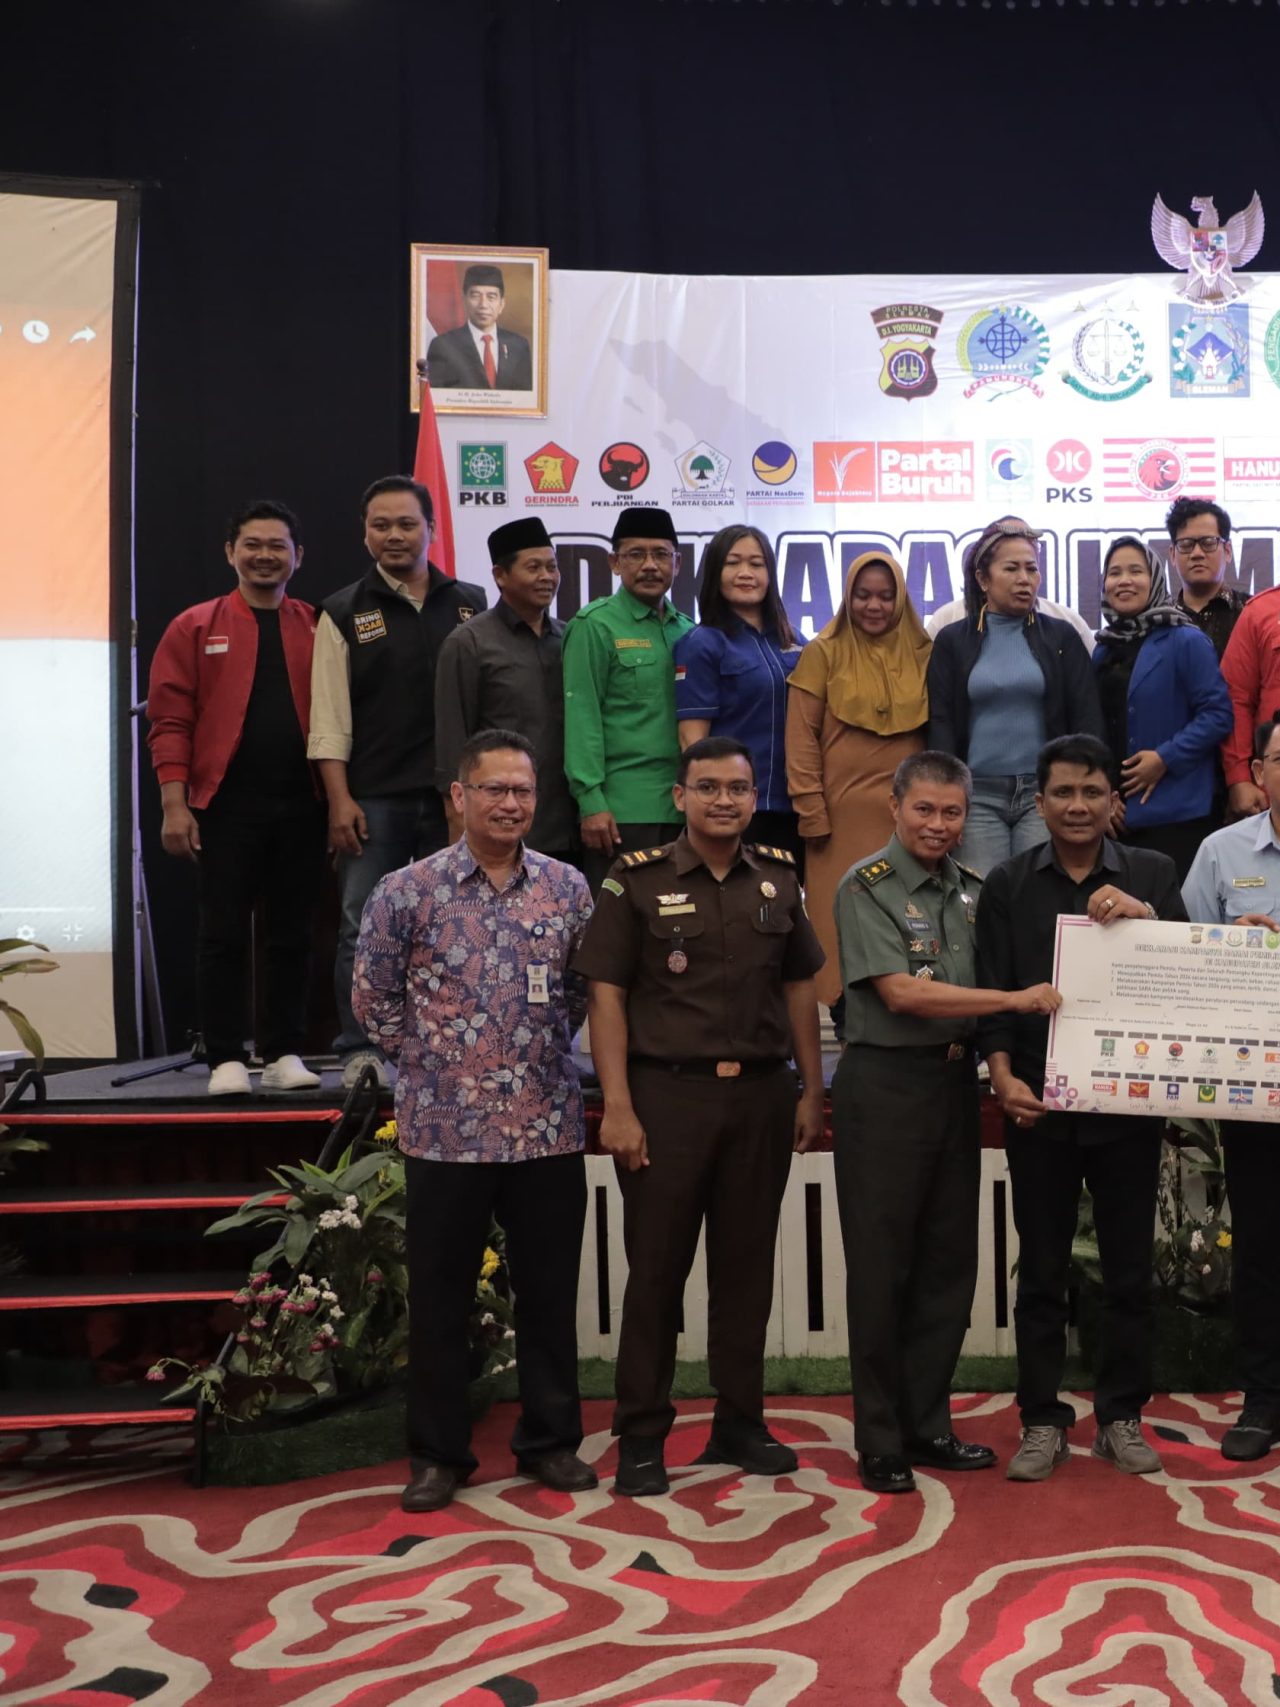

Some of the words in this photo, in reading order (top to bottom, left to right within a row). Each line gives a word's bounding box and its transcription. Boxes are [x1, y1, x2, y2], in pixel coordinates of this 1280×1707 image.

[892, 324, 932, 335] YOGYAKARTA
[880, 471, 972, 495] Buruh
[459, 492, 507, 505] PKB
[525, 496, 579, 504] GERINDRA
[1046, 487, 1093, 503] PKS
